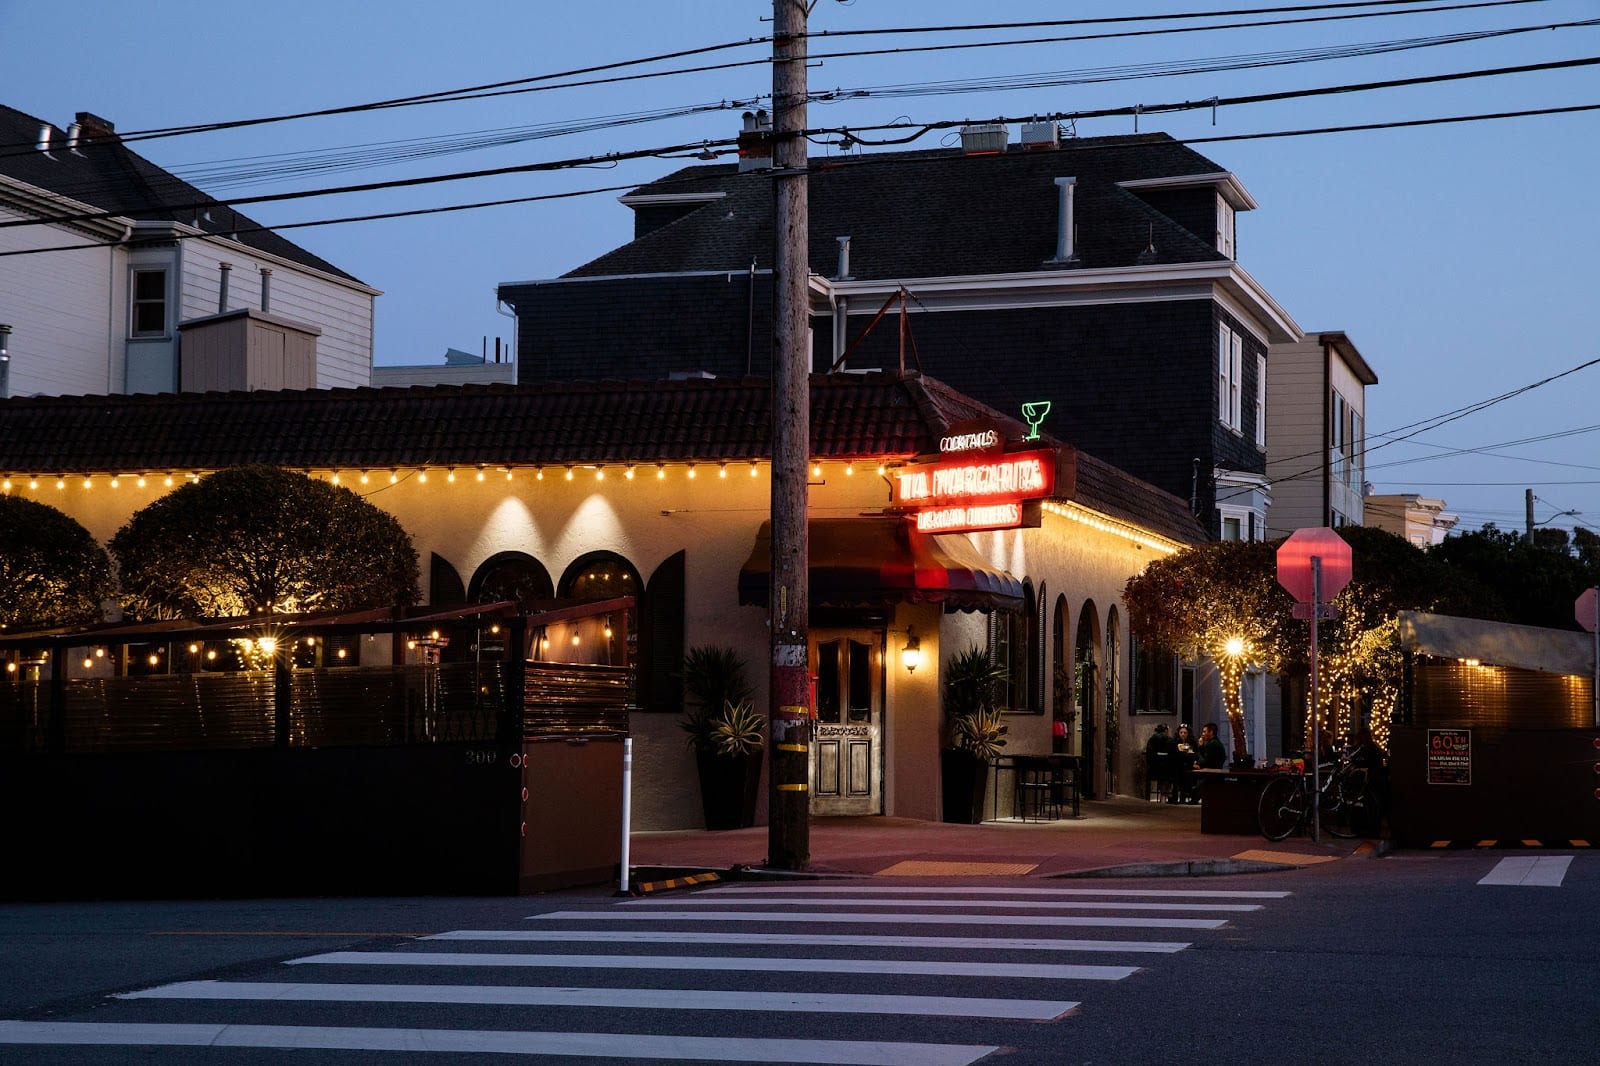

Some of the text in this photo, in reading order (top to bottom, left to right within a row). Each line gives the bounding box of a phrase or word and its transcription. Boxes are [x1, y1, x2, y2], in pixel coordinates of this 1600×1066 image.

[940, 429, 996, 452] COCKTAILS
[897, 460, 1043, 499] TIA MARGARITA
